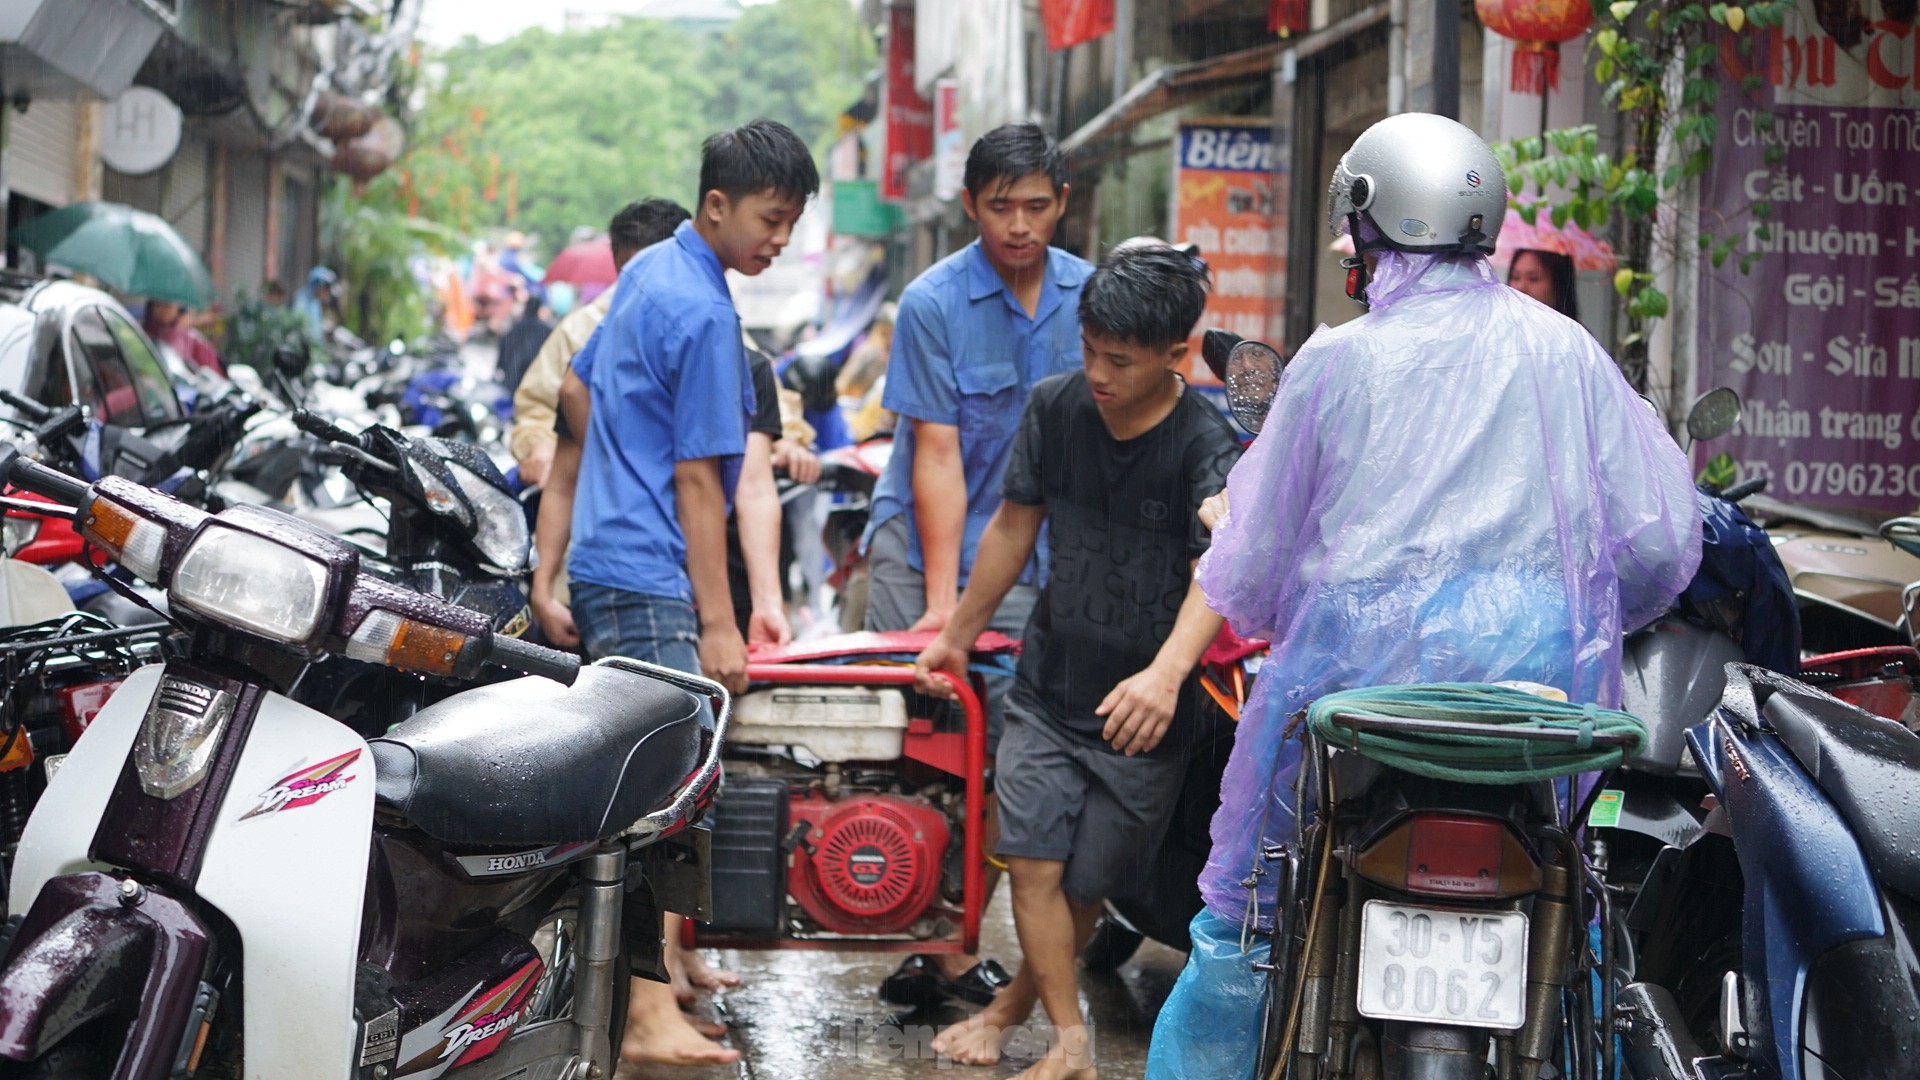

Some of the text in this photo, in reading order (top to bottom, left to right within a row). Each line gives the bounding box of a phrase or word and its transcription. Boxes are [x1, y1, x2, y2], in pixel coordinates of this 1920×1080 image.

[1829, 111, 1875, 157] Tạo
[1744, 166, 1805, 202] Cắt
[1833, 169, 1907, 206] Uốn
[1746, 221, 1879, 260] Nhuộm
[1784, 273, 1845, 311] Gội
[1729, 332, 1792, 375] Sơn
[1825, 332, 1888, 377] Sửa
[1731, 400, 1811, 448] Nhận
[1820, 405, 1902, 449] trang
[163, 680, 212, 700] HONDA
[257, 776, 347, 812] DREAM
[487, 851, 546, 871] HONDA
[1385, 911, 1503, 965] 30-Y5
[1383, 963, 1502, 1019] 8062
[438, 1011, 520, 1060] DREAM
